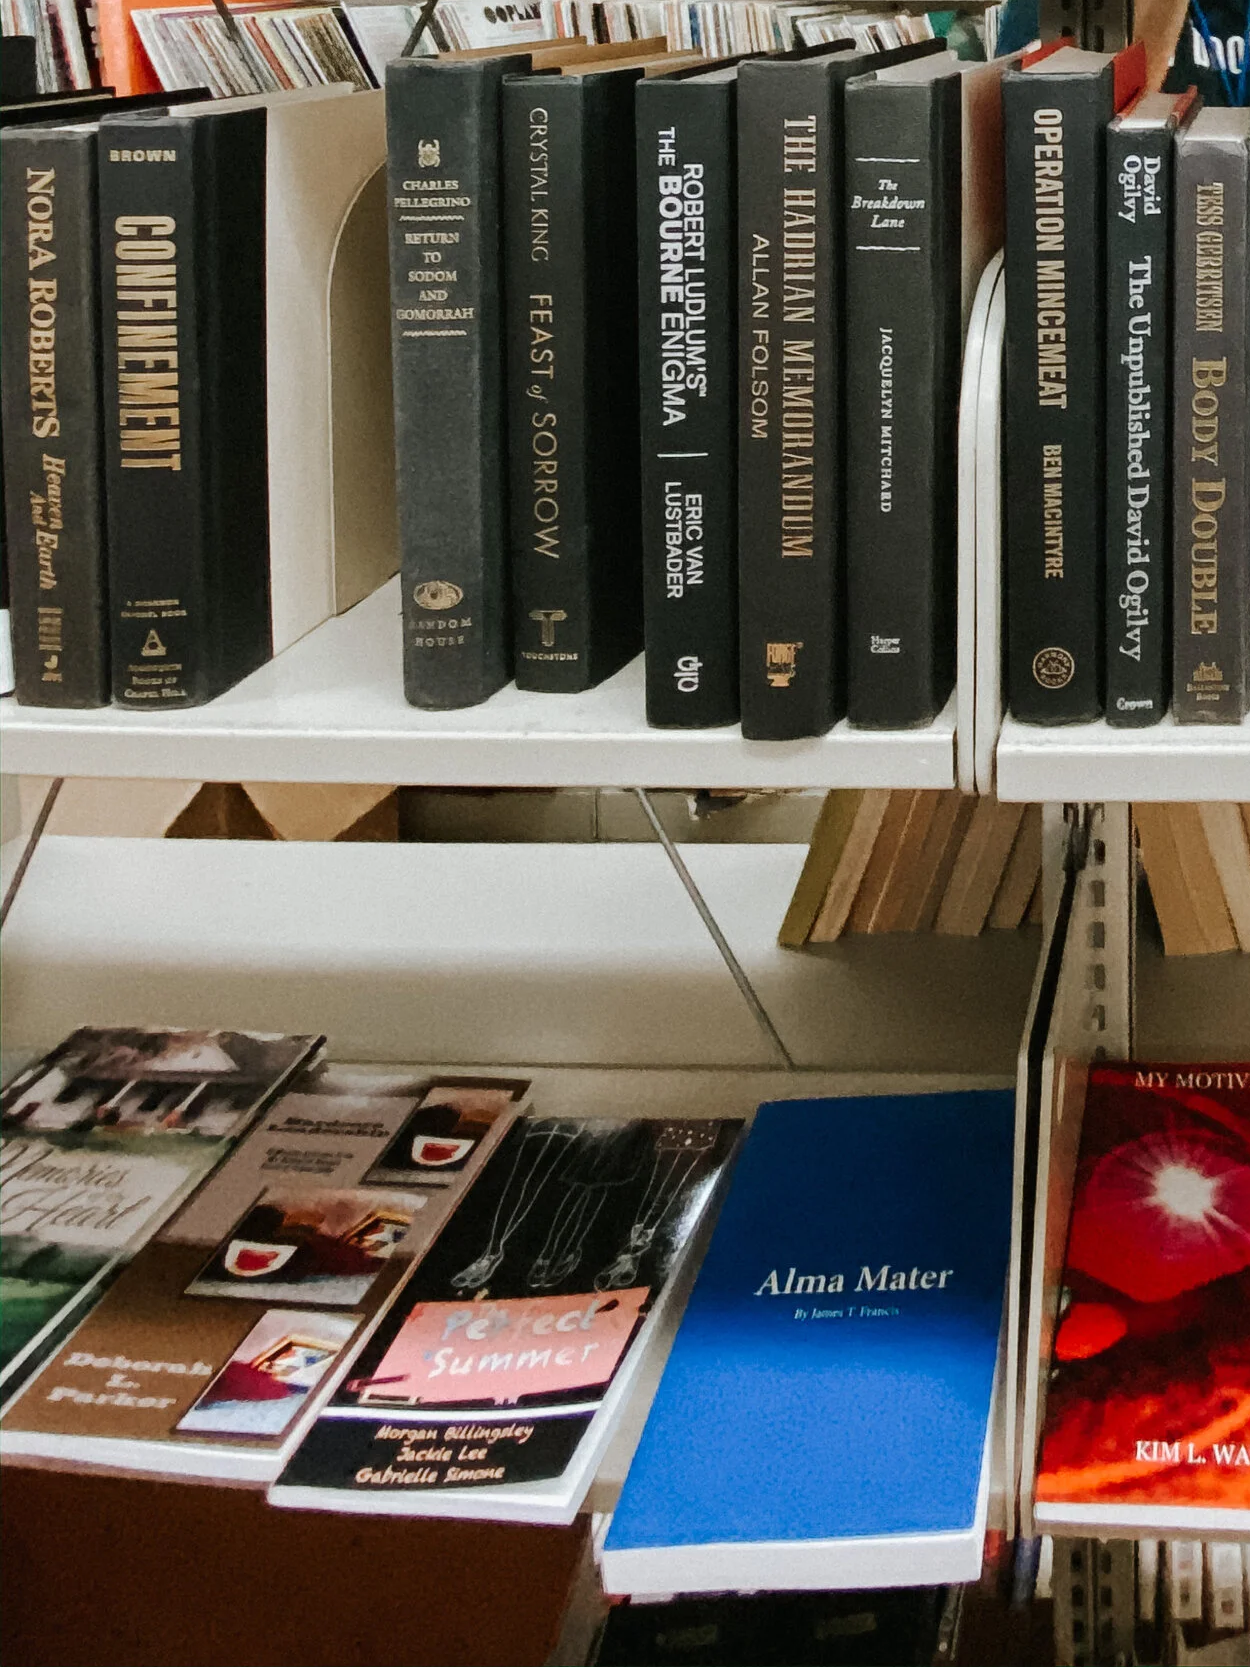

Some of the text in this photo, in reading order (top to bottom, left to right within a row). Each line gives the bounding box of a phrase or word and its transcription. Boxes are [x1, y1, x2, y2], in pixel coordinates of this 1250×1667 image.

[109, 149, 176, 163] BROWN
[1143, 156, 1161, 215] David
[683, 163, 705, 261] ROBERT
[851, 196, 925, 209] Breakdown
[1118, 155, 1142, 223] Ogilvy
[871, 215, 905, 228] Lane
[408, 270, 457, 283] SODOM
[423, 251, 442, 264] TO
[658, 127, 686, 426] THE BOURNE ENIGMA
[1033, 108, 1067, 409] OPERATION MINCEMEAT
[26, 167, 61, 438] NORA ROBERTS
[419, 289, 449, 302] AND
[115, 215, 181, 471] CONFINEMENT
[529, 107, 560, 559] CRYSTAL KING FEAST SORROW
[751, 233, 770, 439] ALLAN FOLSOM
[781, 115, 817, 558] THE HADRIAN MEMORANDUM
[1119, 256, 1151, 662] The Unpublished David Ogilvy
[1043, 444, 1063, 579] BEN MACINTYRE
[1191, 356, 1227, 635] BODY DOUBLE
[665, 481, 684, 599] LUSTBADER
[685, 493, 704, 585] ERIC VAN
[1135, 1072, 1169, 1089] MY
[753, 1265, 954, 1296] Alma Mater
[427, 1342, 600, 1379] Summer
[375, 1424, 535, 1444] Morgan Billingsley
[458, 1447, 488, 1460] Lee
[1135, 1440, 1180, 1462] KIM
[1187, 1443, 1206, 1464] L.
[355, 1466, 506, 1484] Gabrielle Simone
